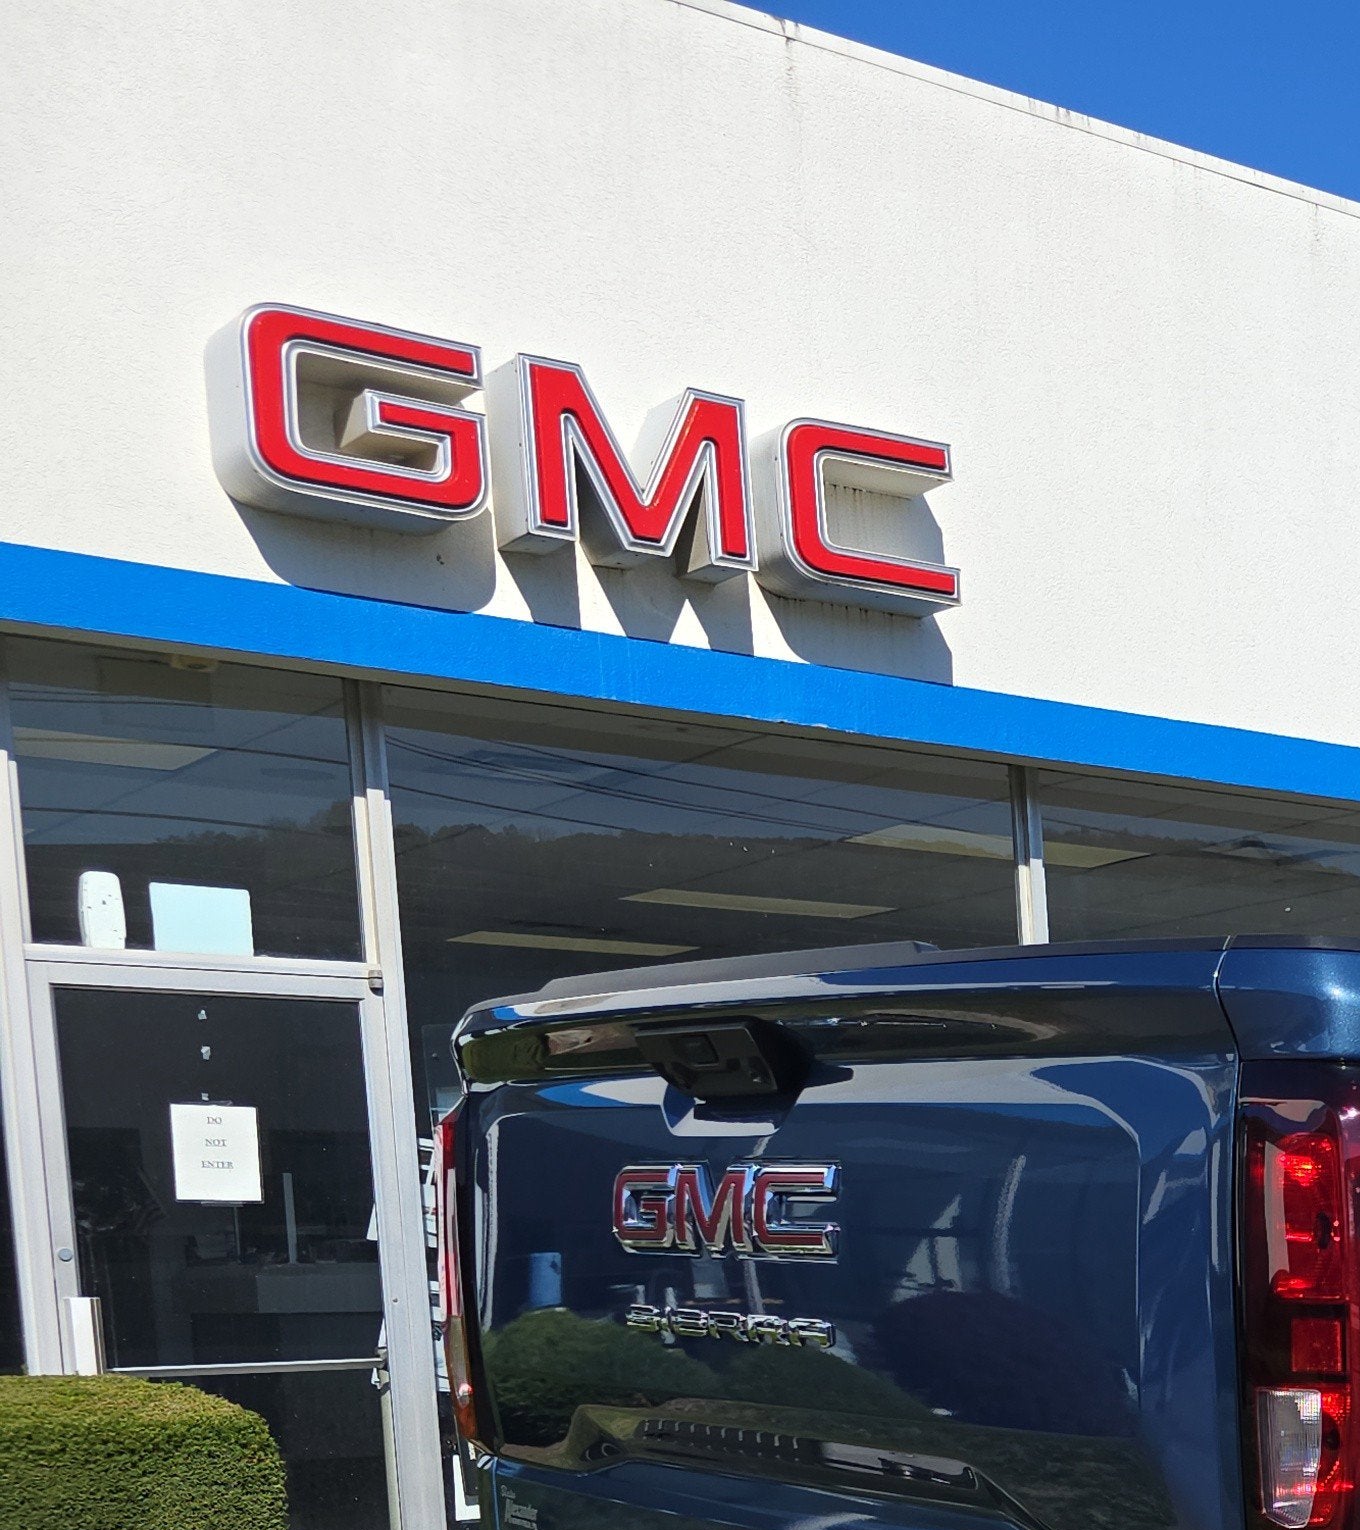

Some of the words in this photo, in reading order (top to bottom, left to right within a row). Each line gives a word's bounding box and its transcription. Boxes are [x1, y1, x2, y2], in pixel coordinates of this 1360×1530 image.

[238, 302, 962, 610] GMC
[206, 1116, 223, 1125] DO
[204, 1138, 228, 1147] NOT
[201, 1160, 234, 1169] ENTER
[612, 1163, 842, 1256] GMC
